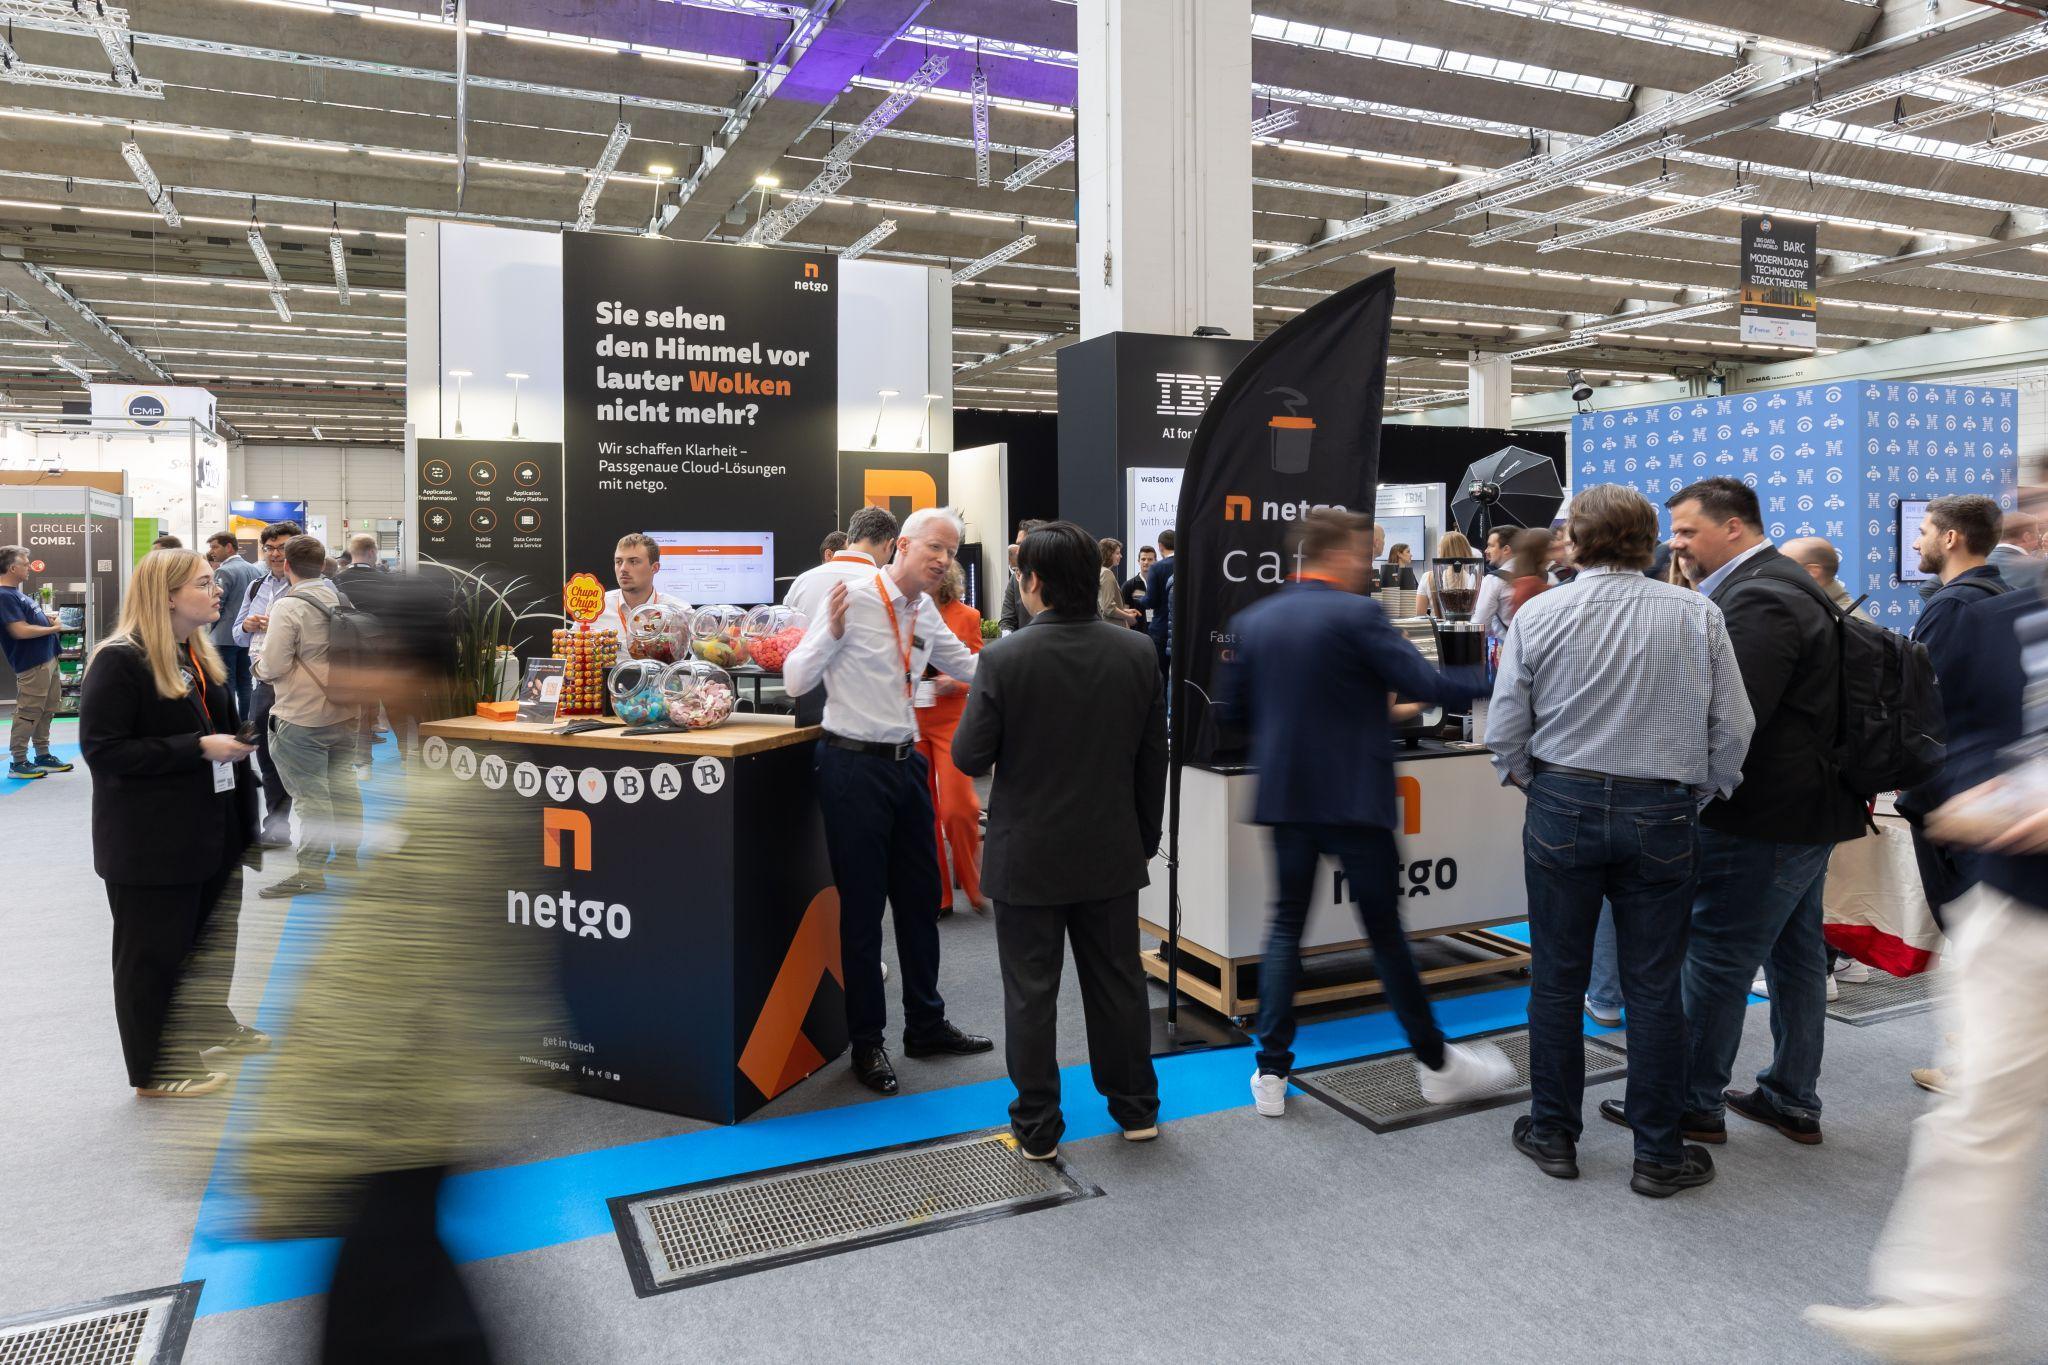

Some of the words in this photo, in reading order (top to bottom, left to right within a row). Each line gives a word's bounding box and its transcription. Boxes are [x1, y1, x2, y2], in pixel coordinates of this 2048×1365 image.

[1784, 241, 1806, 253] BARC
[1750, 253, 1782, 265] MODERN
[1784, 258, 1803, 267] DATA
[1755, 265, 1804, 278] TECHNOLOGY
[794, 279, 828, 292] netgo
[1751, 276, 1774, 286] STACK
[1775, 278, 1808, 289] THEATRE
[596, 301, 639, 326] Sie
[645, 305, 726, 331] sehen
[596, 334, 648, 359] den
[655, 337, 762, 364] Himmel
[767, 347, 810, 367] vor
[596, 366, 684, 391] lauter
[689, 370, 791, 396] Wolken
[597, 398, 670, 422] nicht
[676, 403, 759, 426] mehr?
[1162, 428, 1174, 438] AI
[1177, 428, 1192, 438] for
[598, 443, 622, 456] Wir
[625, 442, 682, 456] schaffen
[686, 444, 737, 457] Klarheit
[599, 460, 678, 476] Passgenaue
[681, 460, 786, 476] Cloud-Lösungen
[599, 477, 622, 490] mit
[625, 478, 668, 492] netgo.
[1405, 492, 1423, 503] IBM
[1141, 503, 1155, 512] Put
[1159, 503, 1169, 512] AI
[1262, 500, 1348, 520] net
[30, 524, 103, 533] CIRCLELOCK
[1141, 518, 1160, 526] with
[30, 536, 75, 545] COMBI.
[1222, 539, 1305, 584] caf
[572, 586, 598, 599] Chupa
[570, 597, 597, 609] Chups
[1210, 631, 1236, 643] Fast
[429, 744, 567, 794] CANDY
[622, 764, 720, 795] BAR
[508, 890, 631, 939] netgo
[543, 1037, 557, 1046] get
[560, 1037, 567, 1048] in
[569, 1041, 594, 1053] touch
[520, 1056, 569, 1071] www.netgo.de
